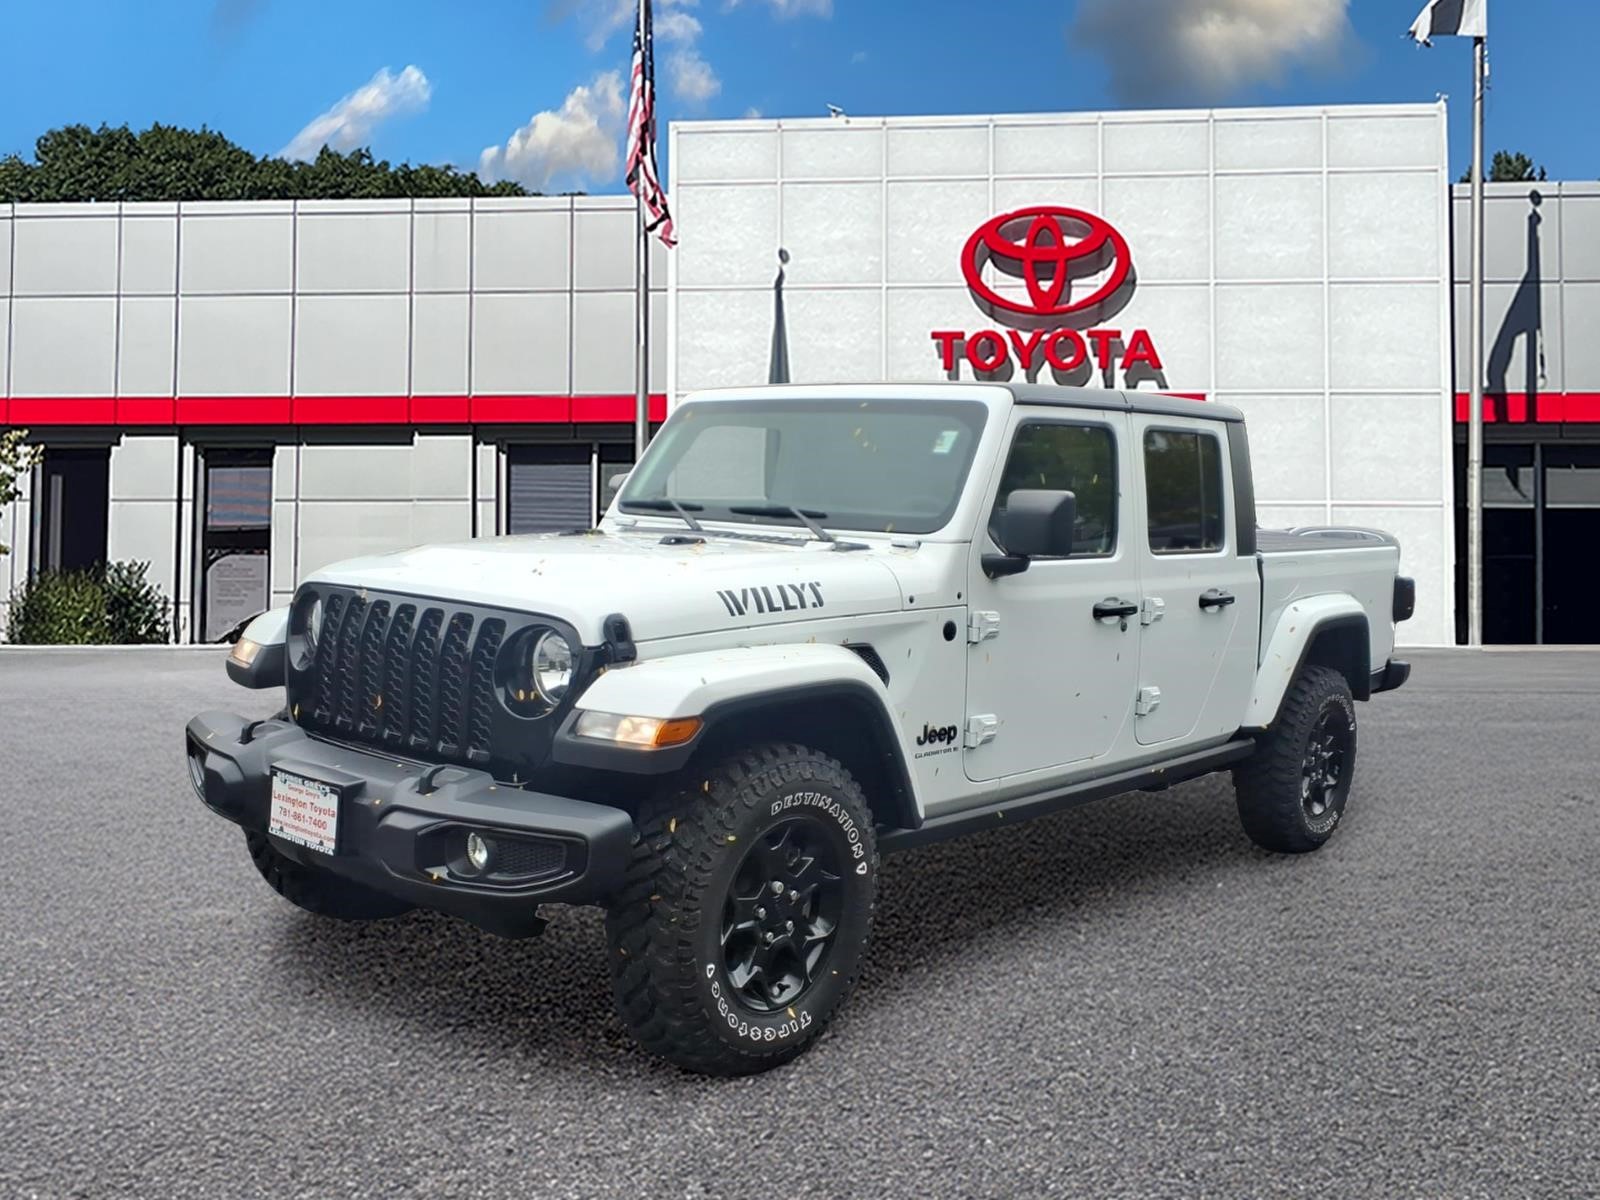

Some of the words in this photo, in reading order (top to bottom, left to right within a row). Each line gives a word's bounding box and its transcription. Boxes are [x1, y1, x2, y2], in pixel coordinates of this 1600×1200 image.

[931, 329, 1162, 371] TOYOTA
[716, 581, 824, 617] WILLYS
[916, 724, 957, 746] Jeep
[273, 791, 308, 809] Lexington
[309, 803, 336, 818] Toyota
[279, 806, 328, 830] 781-861-7400
[770, 791, 864, 859] DESTINATION
[305, 841, 334, 856] TOYOTA
